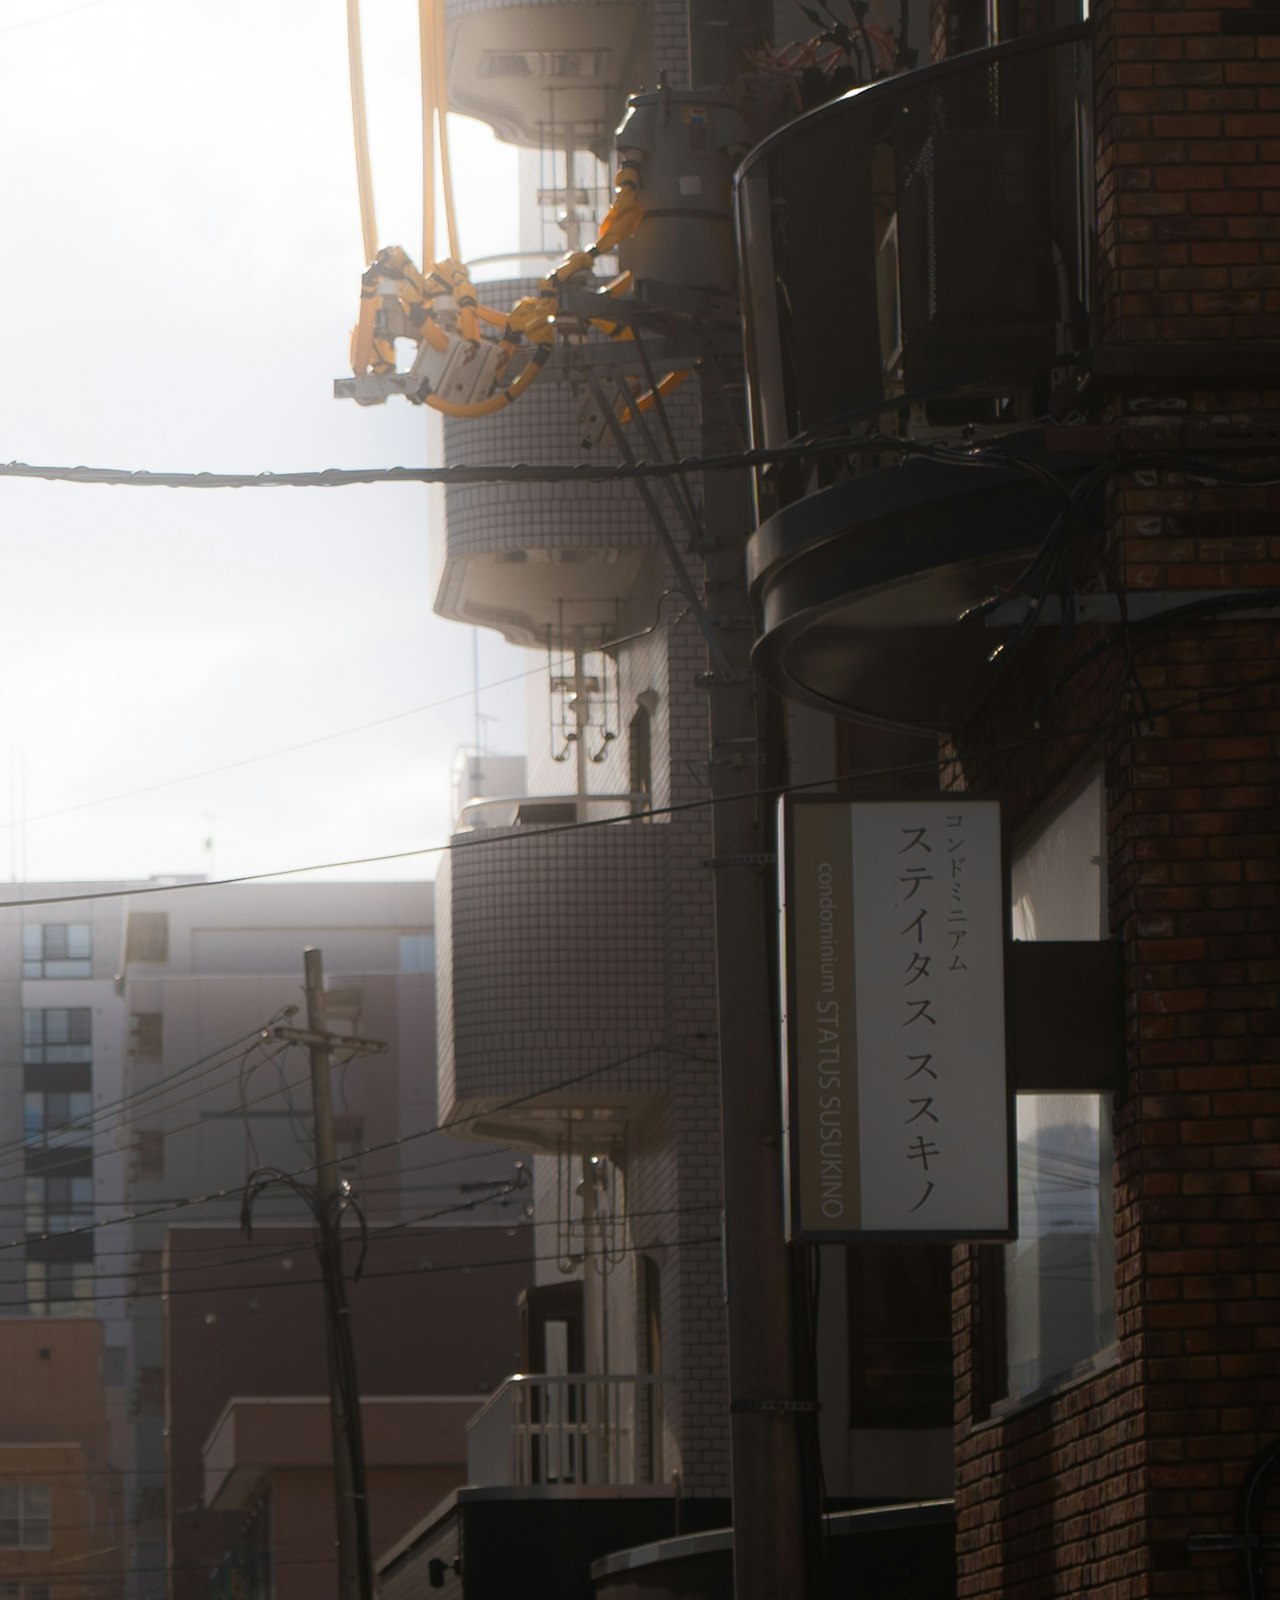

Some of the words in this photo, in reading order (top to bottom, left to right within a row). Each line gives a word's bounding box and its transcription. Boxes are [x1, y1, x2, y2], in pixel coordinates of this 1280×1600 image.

[816, 862, 839, 994] condominium
[897, 824, 937, 1027] ステイタス
[946, 814, 967, 973] コンドミニアム
[816, 999, 842, 1090] STATUS
[818, 1095, 845, 1220] SUSUKINO
[903, 1051, 941, 1215] ススキノ
